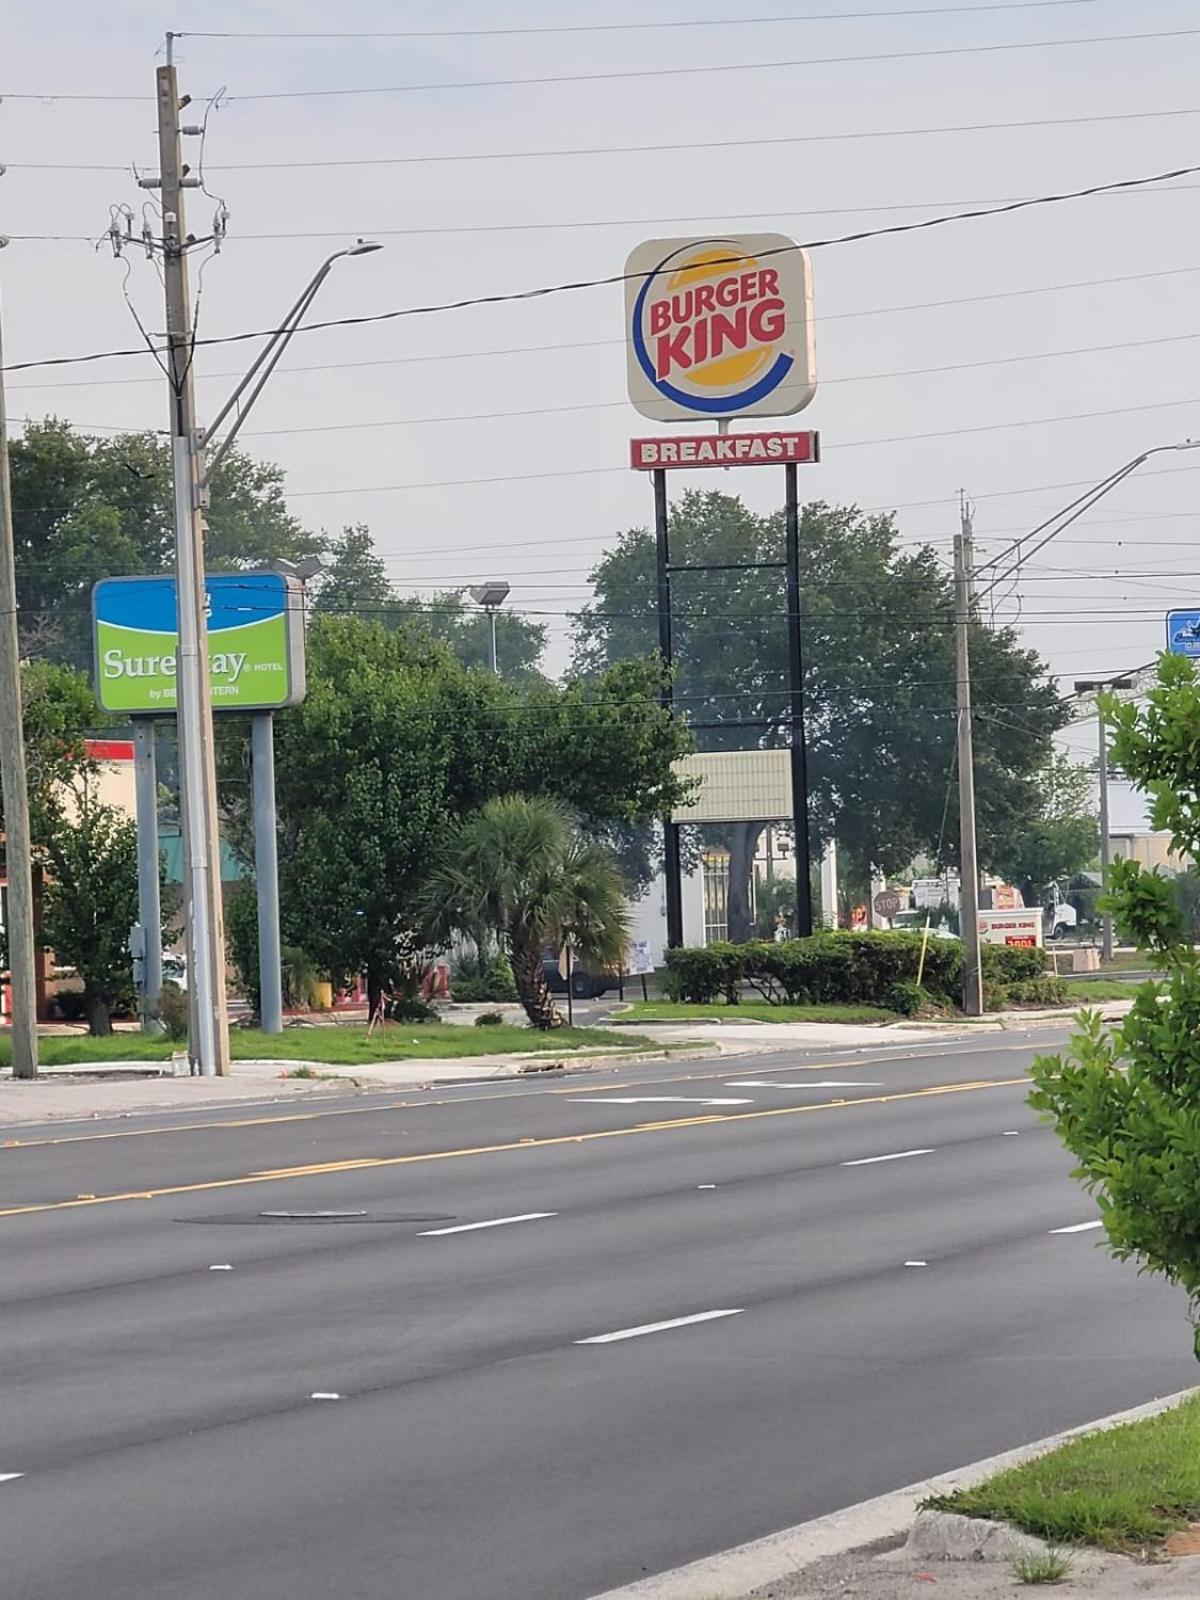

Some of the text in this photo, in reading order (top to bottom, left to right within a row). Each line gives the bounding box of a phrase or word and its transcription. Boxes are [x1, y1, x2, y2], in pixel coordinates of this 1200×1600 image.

[651, 269, 779, 336] BURGER
[657, 298, 785, 380] KING
[640, 437, 799, 464] BREAKFAST
[104, 649, 284, 683] Sureay HOTEL
[149, 688, 162, 699] by
[874, 897, 898, 912] STOP
